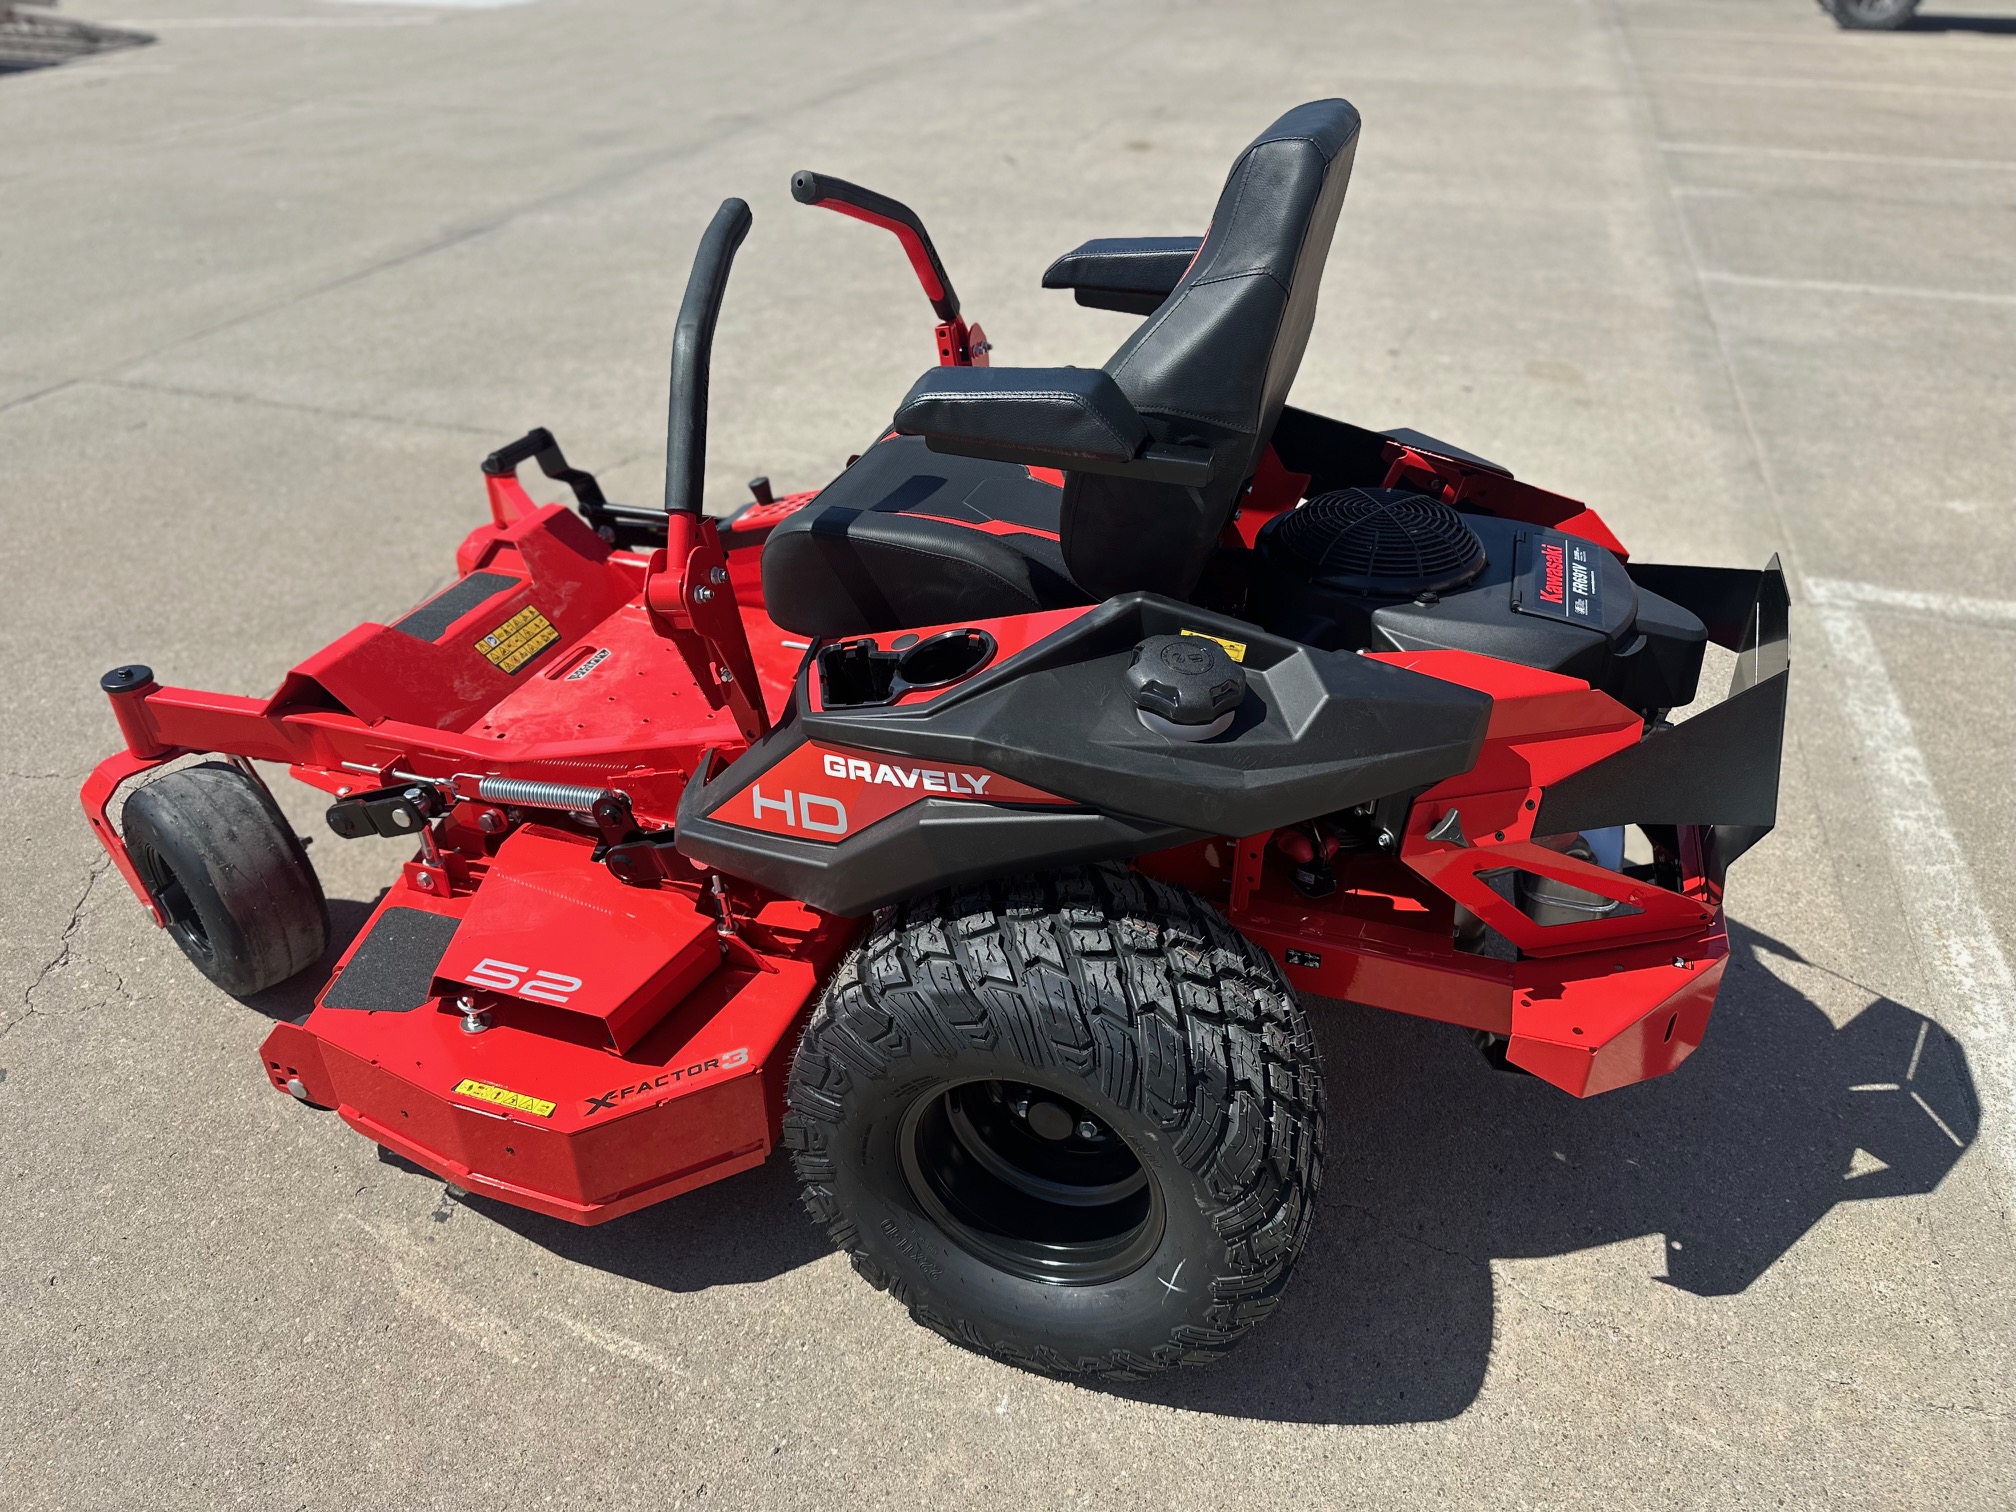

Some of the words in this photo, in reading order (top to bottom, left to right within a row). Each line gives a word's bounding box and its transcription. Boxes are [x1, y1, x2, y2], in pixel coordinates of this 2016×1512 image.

[1540, 544, 1563, 604] Kawasaki
[1572, 562, 1588, 596] FR691V
[823, 754, 991, 795] GRAVELY
[752, 784, 848, 834] HD
[464, 957, 582, 1003] 52
